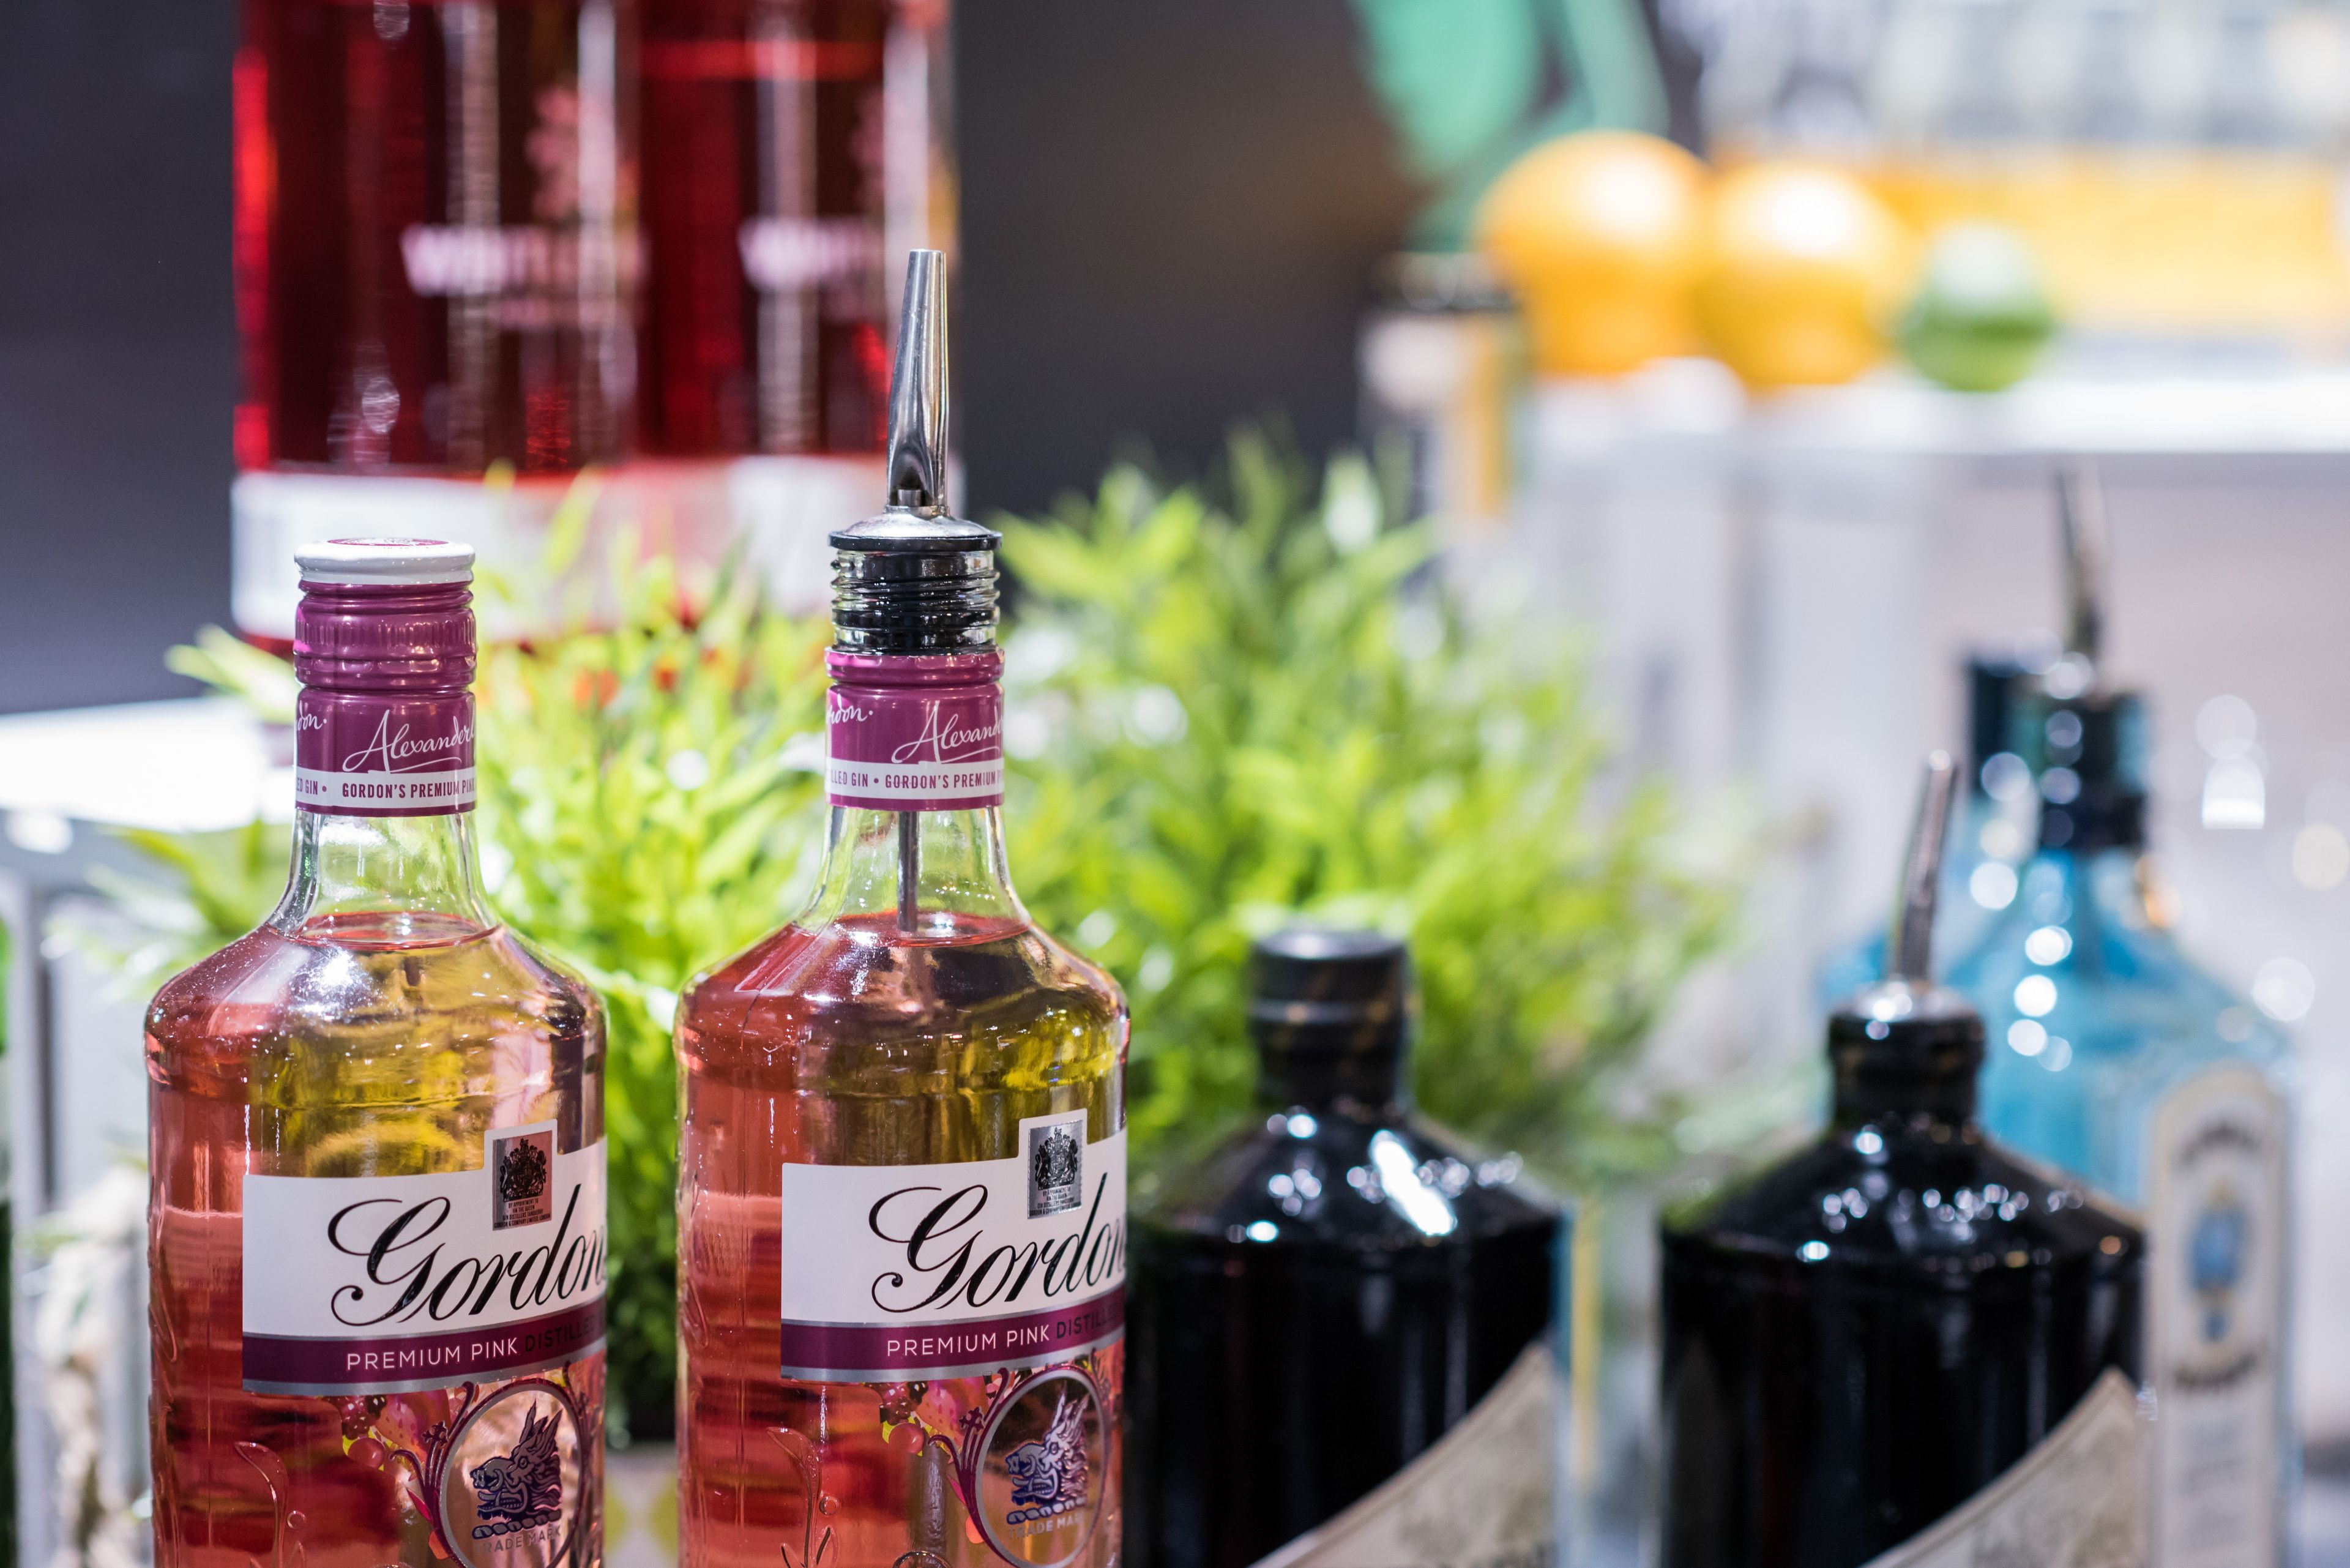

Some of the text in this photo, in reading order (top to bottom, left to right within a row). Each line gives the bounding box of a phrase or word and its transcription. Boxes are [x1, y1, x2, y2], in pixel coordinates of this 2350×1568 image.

[305, 780, 318, 795] GIN
[342, 783, 406, 799] GORDON'S
[411, 781, 459, 798] PREMIUM
[851, 772, 868, 787] GIN
[885, 774, 949, 789] GORDON'S
[954, 771, 996, 788] PREMIUM
[327, 1184, 606, 1327] Gordon
[868, 1173, 1125, 1313] Gordon
[347, 1345, 460, 1371] PREMIUM
[471, 1337, 518, 1361] PINK
[887, 1333, 996, 1357] PREMIUM
[1007, 1324, 1050, 1348] PINK
